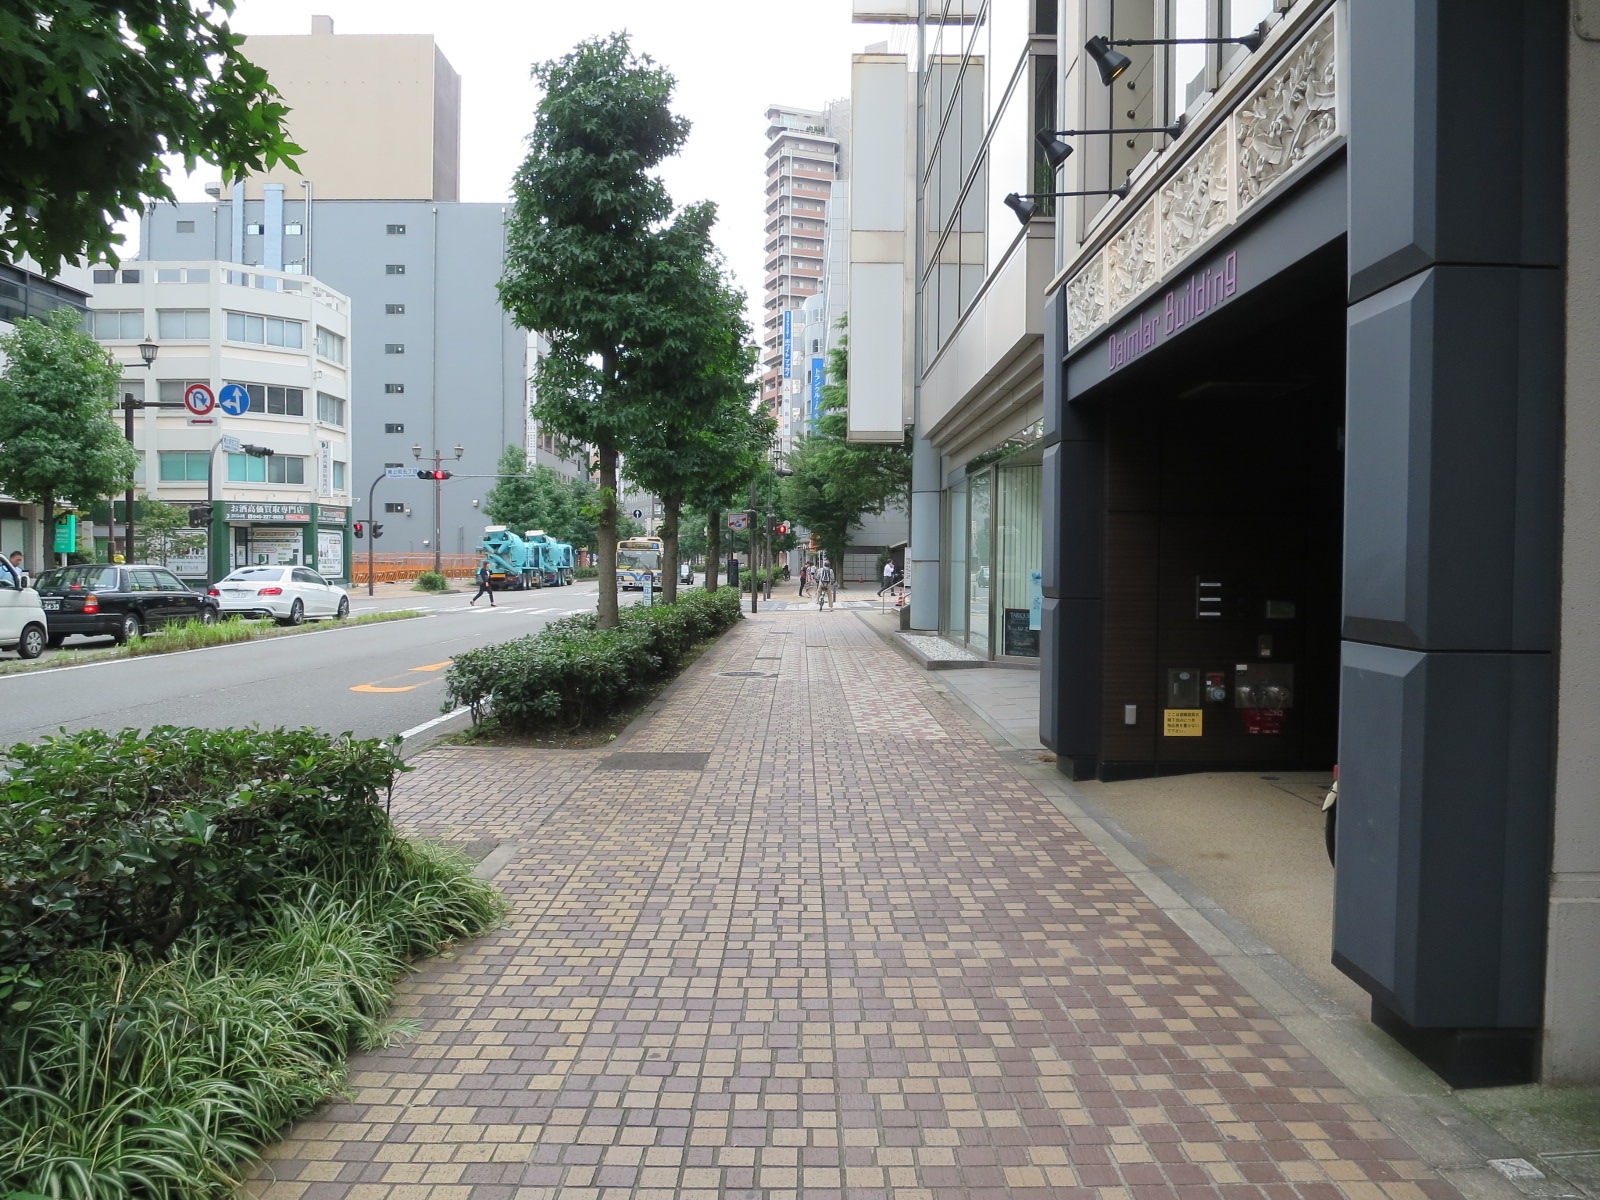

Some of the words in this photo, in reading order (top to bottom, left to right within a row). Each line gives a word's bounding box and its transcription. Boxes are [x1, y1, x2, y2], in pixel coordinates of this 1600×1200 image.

[1109, 313, 1160, 372] Daimlar
[1165, 250, 1237, 336] Building
[230, 504, 305, 514] お酒高価買取専門店
